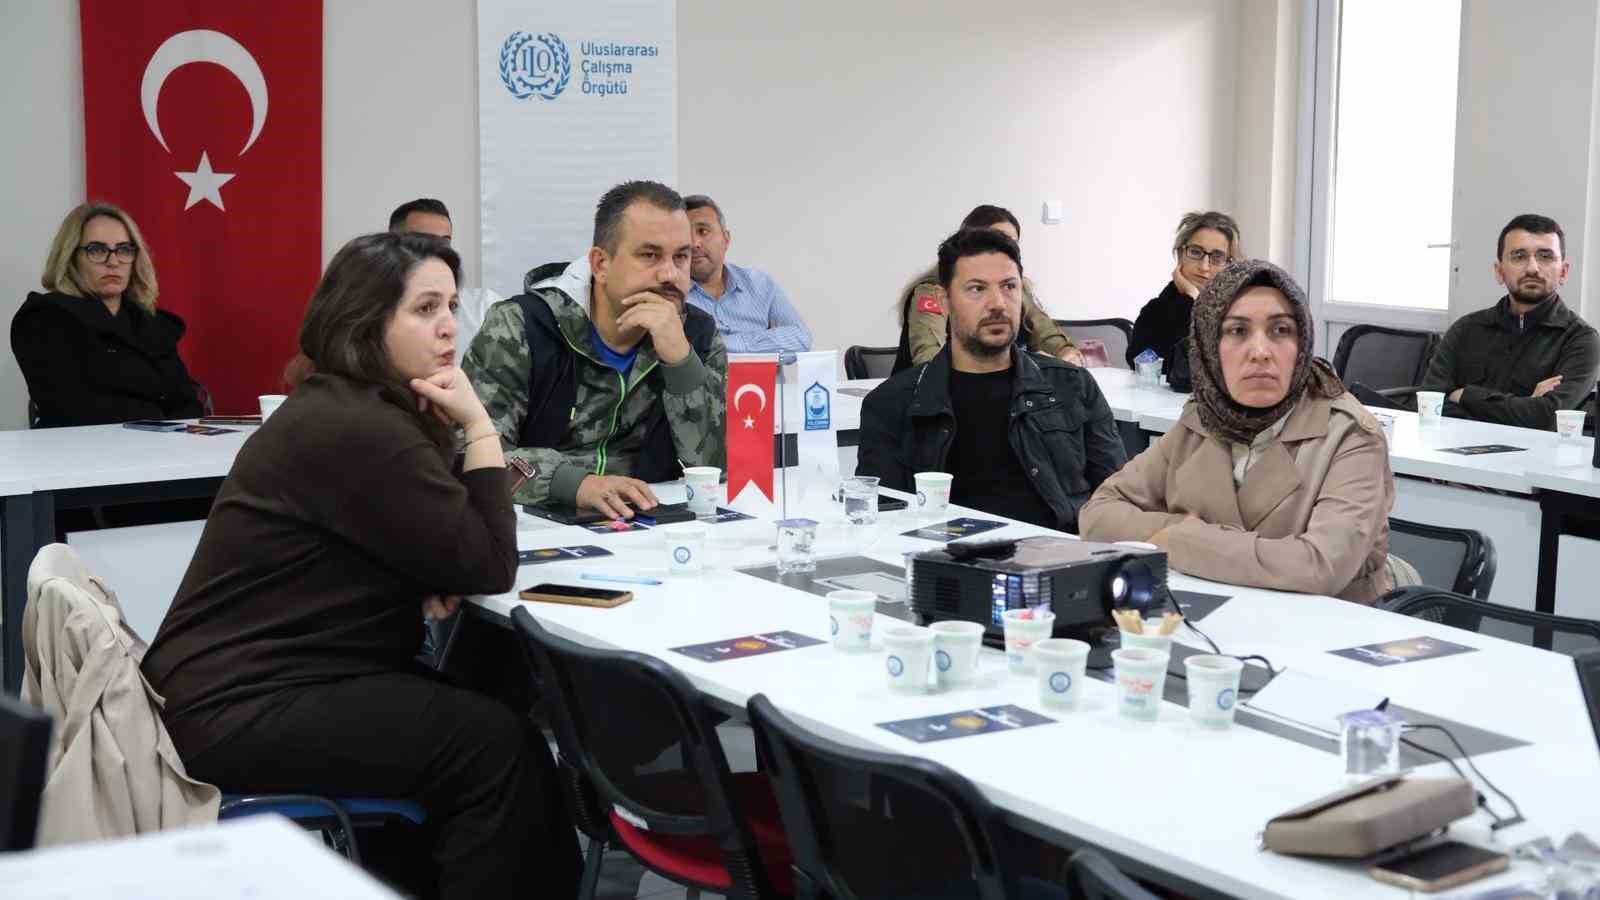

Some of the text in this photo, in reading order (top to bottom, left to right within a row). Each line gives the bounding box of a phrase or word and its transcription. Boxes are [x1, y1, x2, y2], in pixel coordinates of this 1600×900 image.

[581, 42, 658, 57] Uluslararası
[521, 45, 551, 78] ILO
[581, 59, 632, 77] Çalışma
[581, 77, 628, 97] Örgütü
